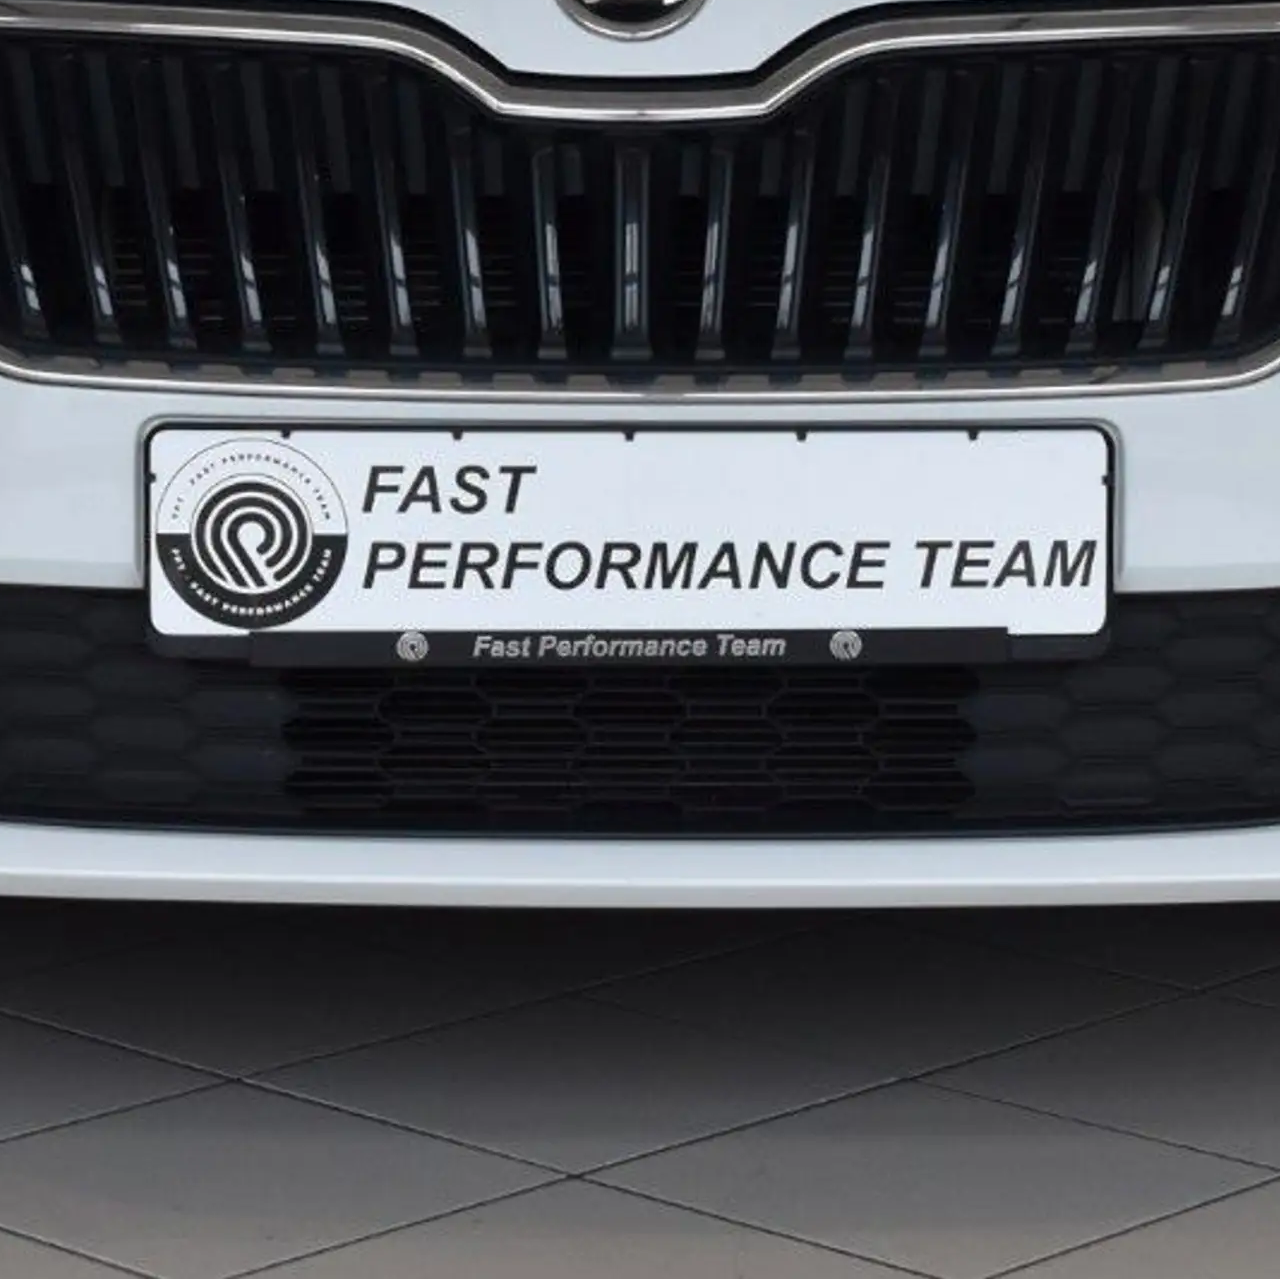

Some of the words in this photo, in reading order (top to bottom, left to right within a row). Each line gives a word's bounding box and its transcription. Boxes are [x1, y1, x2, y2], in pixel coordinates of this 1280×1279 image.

[362, 465, 538, 515] FAST
[362, 540, 891, 590] PERFORMANCE
[915, 539, 1098, 589] TEAM
[472, 634, 532, 658] Fast
[537, 633, 709, 658] Performance
[717, 633, 787, 657] Team
